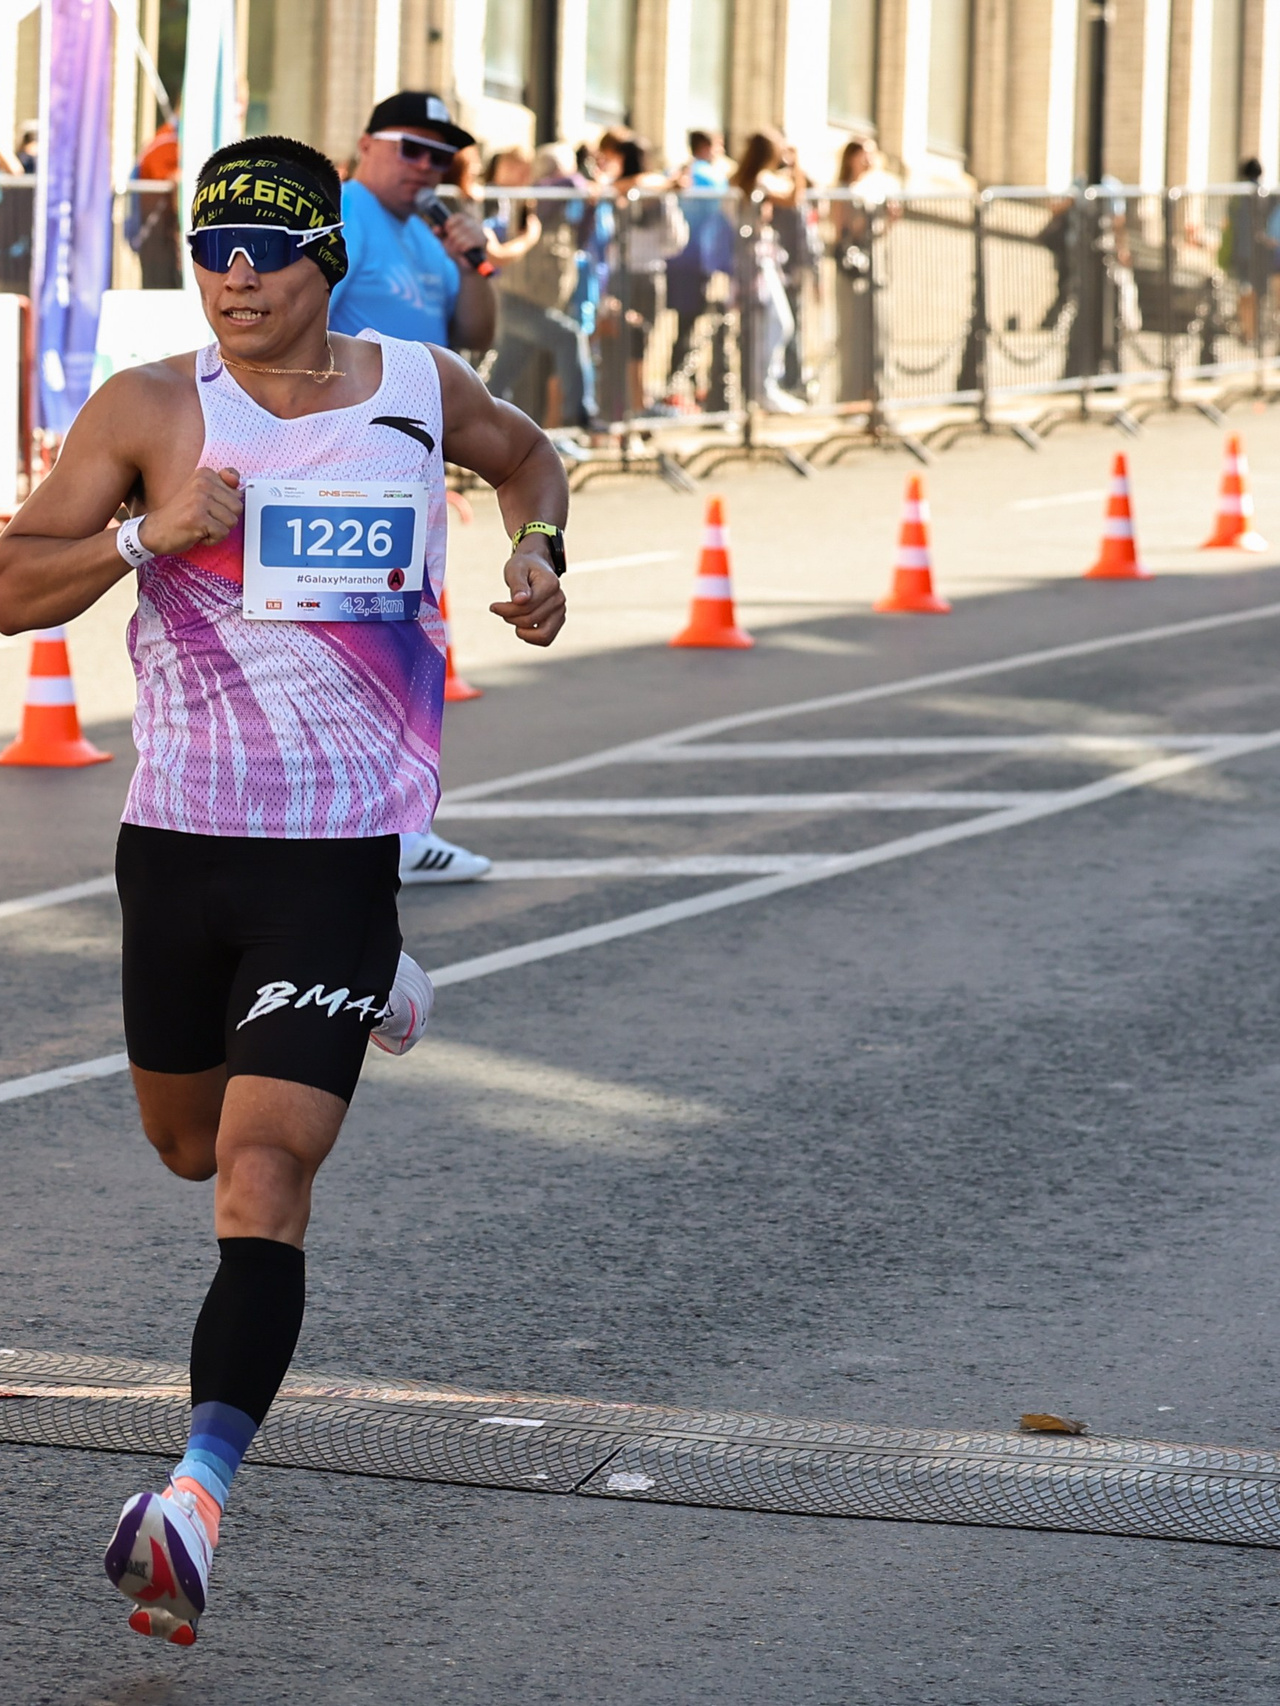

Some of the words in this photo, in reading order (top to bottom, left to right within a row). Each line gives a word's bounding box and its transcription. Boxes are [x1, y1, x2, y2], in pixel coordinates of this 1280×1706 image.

[238, 197, 253, 206] НО
[253, 179, 325, 228] БЕГИ
[286, 518, 393, 557] 1226
[297, 575, 383, 585] #GalaxyMarathon
[390, 571, 401, 586] A
[340, 596, 404, 616] 42,2km
